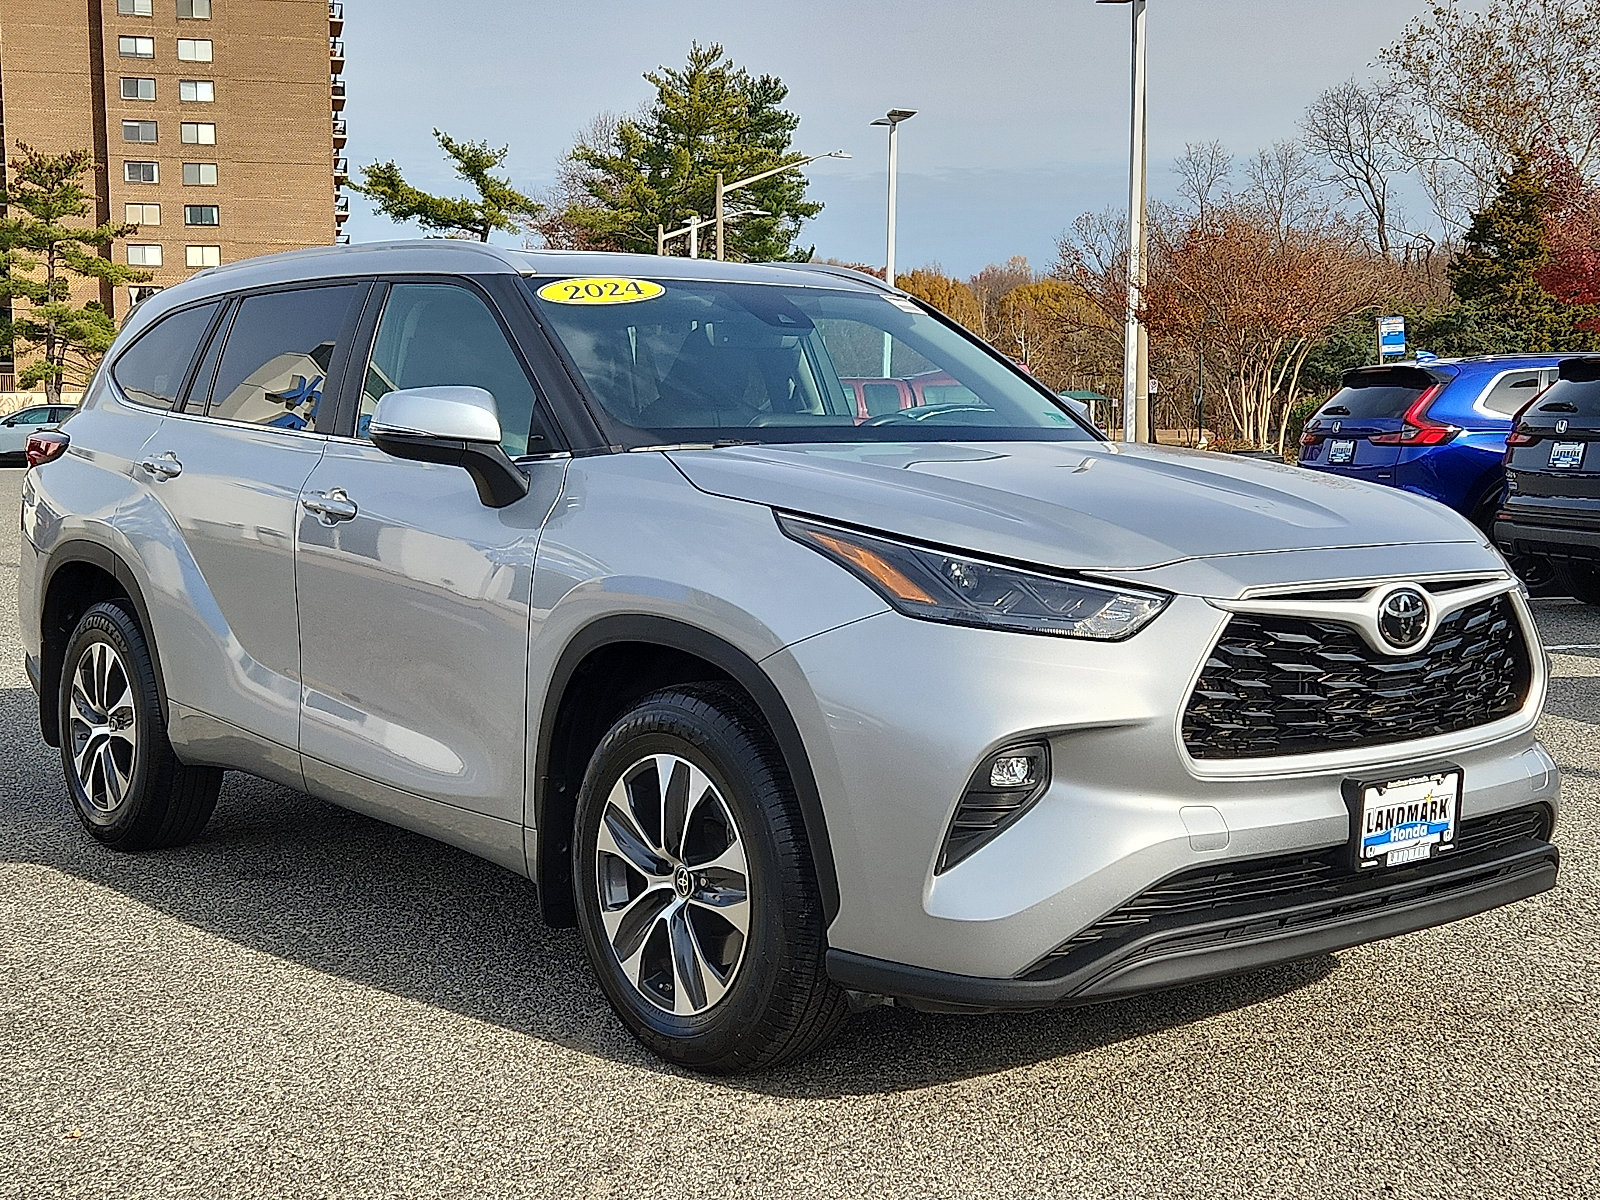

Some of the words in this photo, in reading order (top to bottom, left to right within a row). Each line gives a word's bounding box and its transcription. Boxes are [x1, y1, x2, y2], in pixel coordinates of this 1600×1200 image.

[563, 281, 645, 300] 2024
[1366, 797, 1449, 834] LANDMARK
[1389, 823, 1429, 842] Honda
